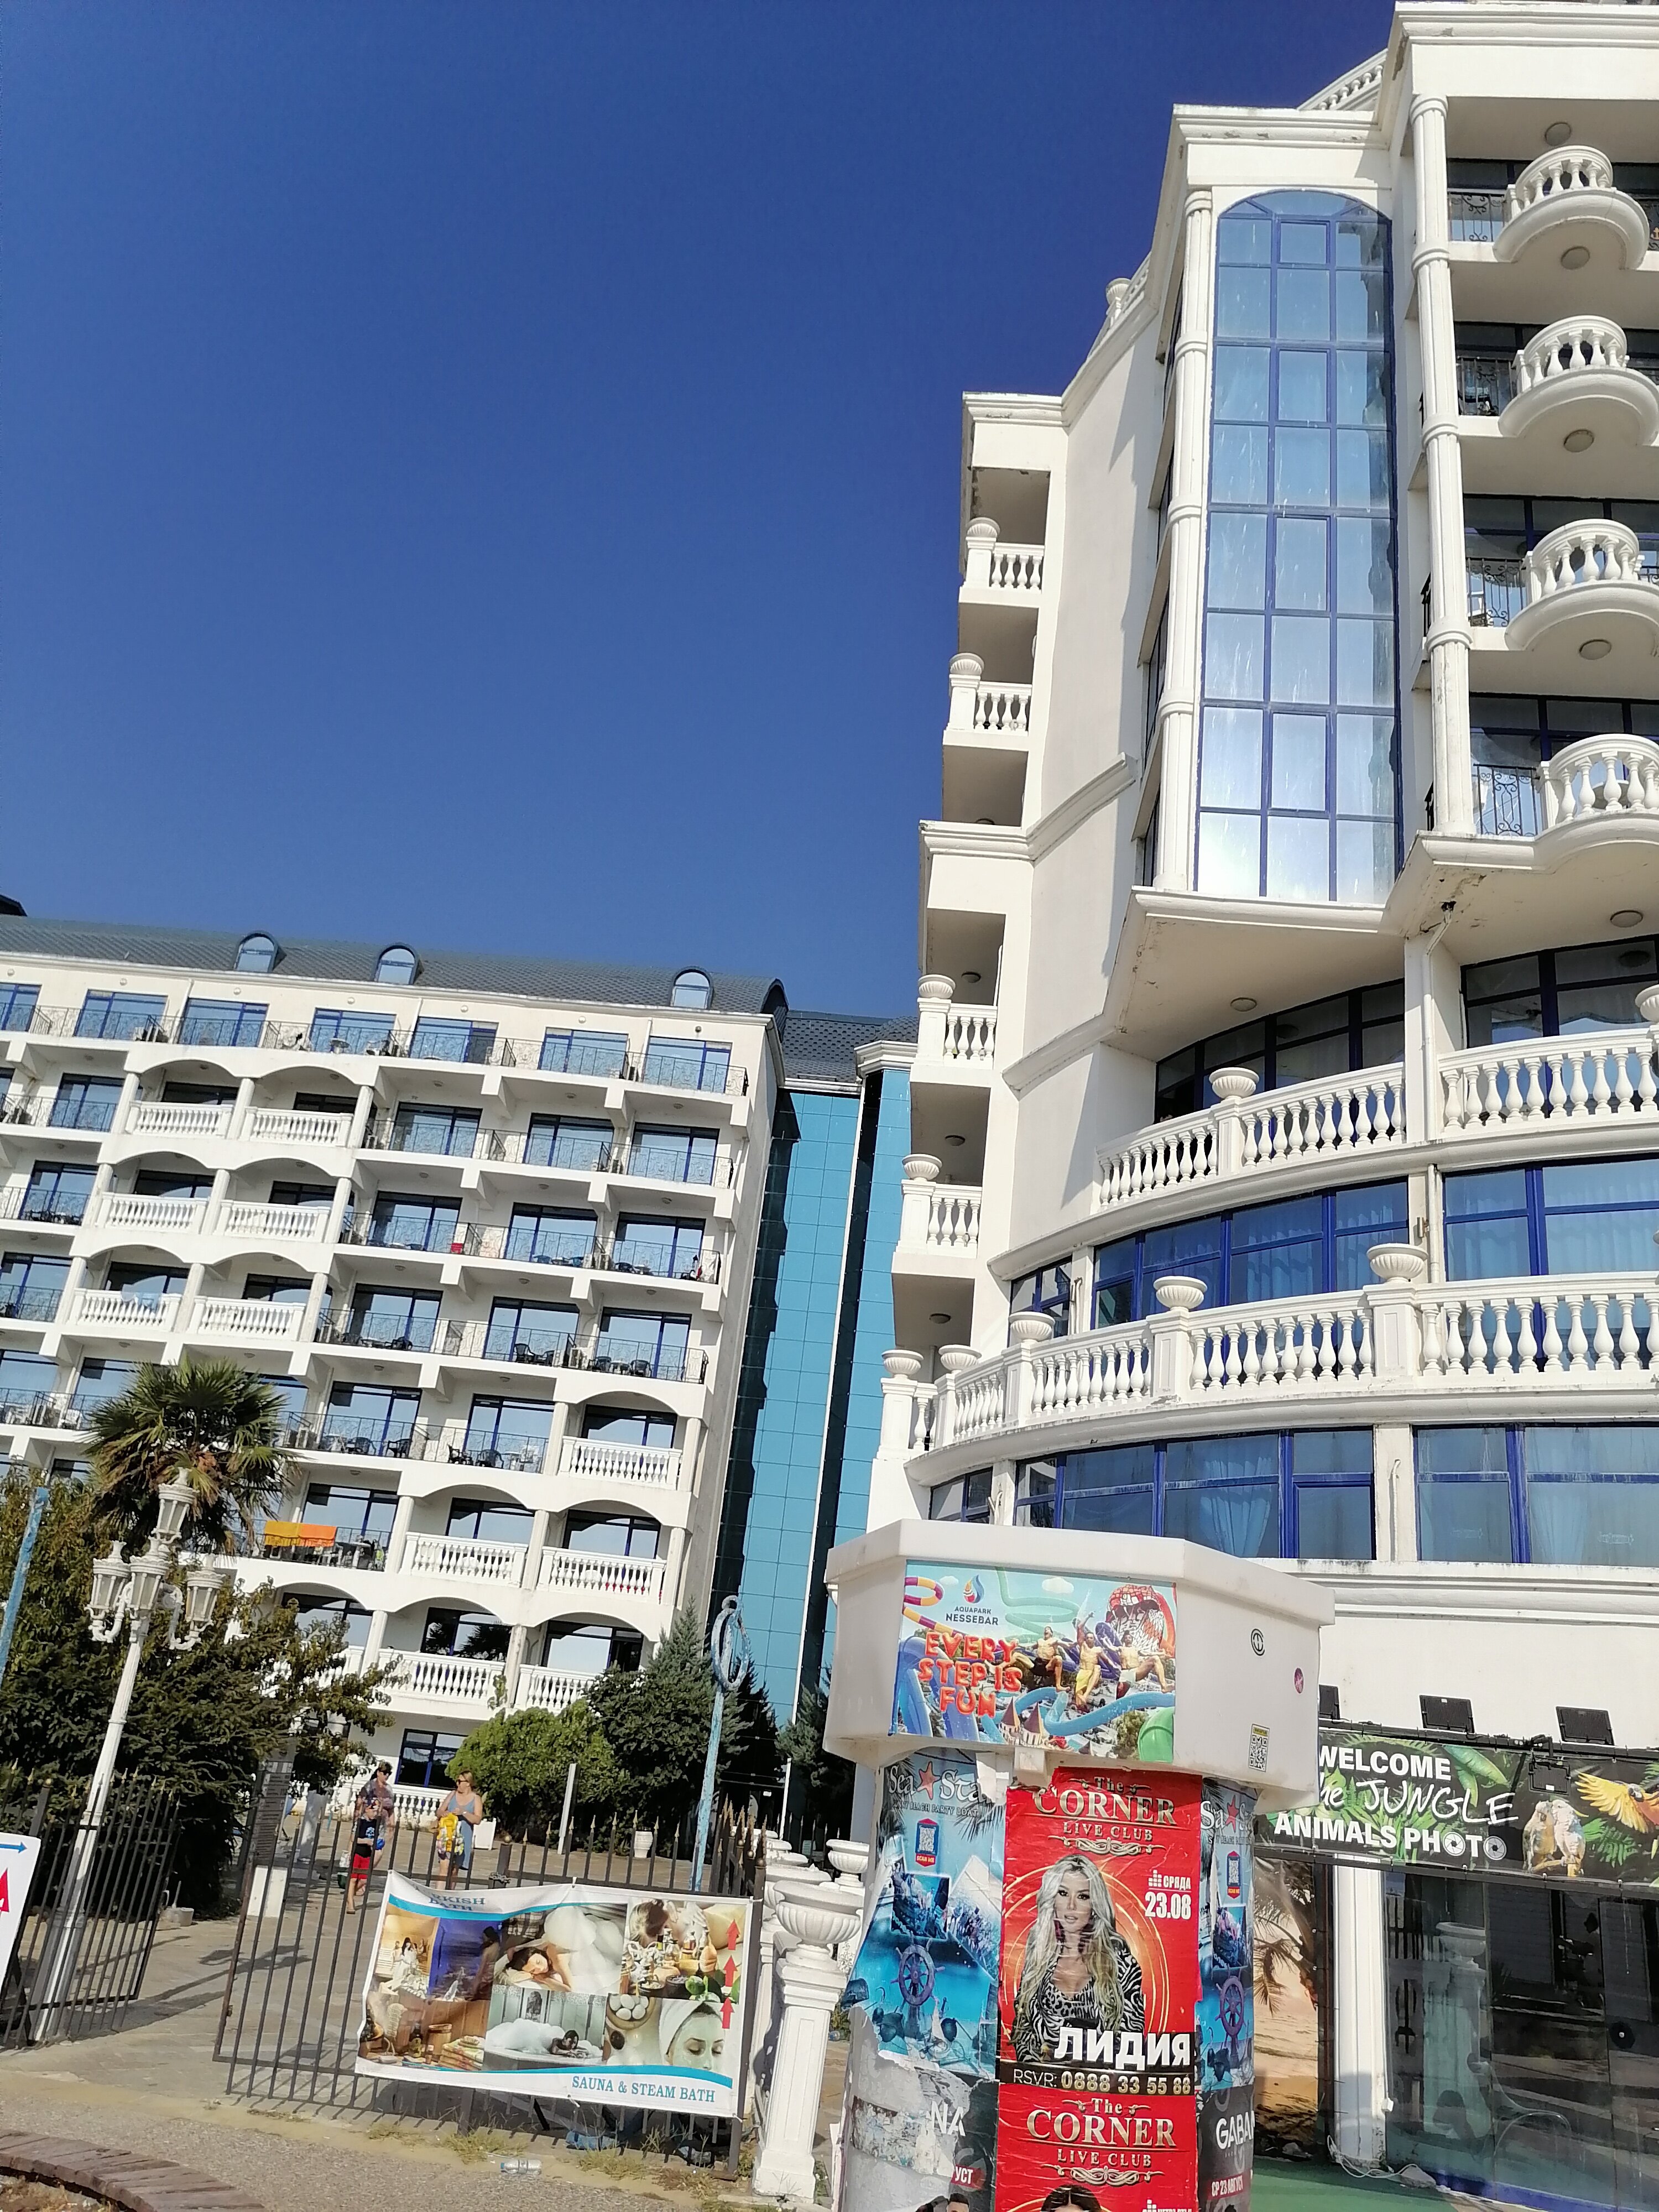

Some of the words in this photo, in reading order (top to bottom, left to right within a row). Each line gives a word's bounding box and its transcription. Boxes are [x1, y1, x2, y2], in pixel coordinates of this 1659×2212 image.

[946, 1613, 998, 1625] NESSEBAR
[954, 1606, 992, 1614] AQUAPARK
[925, 1631, 1019, 1662] EVERY
[918, 1658, 988, 1687] STEP
[994, 1665, 1023, 1692] IS
[940, 1686, 996, 1718] FUN
[1319, 1745, 1452, 1781] WELCOME
[889, 1765, 915, 1795] Sea
[1094, 1776, 1124, 1793] The
[932, 1804, 955, 1815] PARTY
[957, 1807, 978, 1817] BOAT
[1032, 1786, 1177, 1825] CORNER
[1355, 1780, 1519, 1825] JUNGLE
[1063, 1822, 1103, 1837] LIVE
[1110, 1826, 1154, 1841] CLUB
[1274, 1813, 1397, 1848] ANIMALS
[1405, 1827, 1507, 1860] PHOTO
[1163, 1875, 1191, 1891] СРЯДА
[1145, 1891, 1192, 1920] 23.08
[1054, 2026, 1190, 2071] ЛИДИЯ
[572, 2075, 614, 2092] SAUNA
[618, 2081, 627, 2094] &
[632, 2083, 676, 2098] STEAM
[680, 2087, 716, 2103] BATH
[1013, 2069, 1057, 2088] RSVR:
[1061, 2071, 1110, 2092] 0888
[1118, 2075, 1140, 2094] 33
[1147, 2077, 1167, 2095] 55
[1173, 2076, 1191, 2095] 88
[1091, 2098, 1123, 2114] The
[1026, 2109, 1177, 2147] CORNER
[1057, 2149, 1100, 2166] LIVE
[1108, 2153, 1151, 2167] CLUB
[1220, 2180, 1227, 2195] 23
